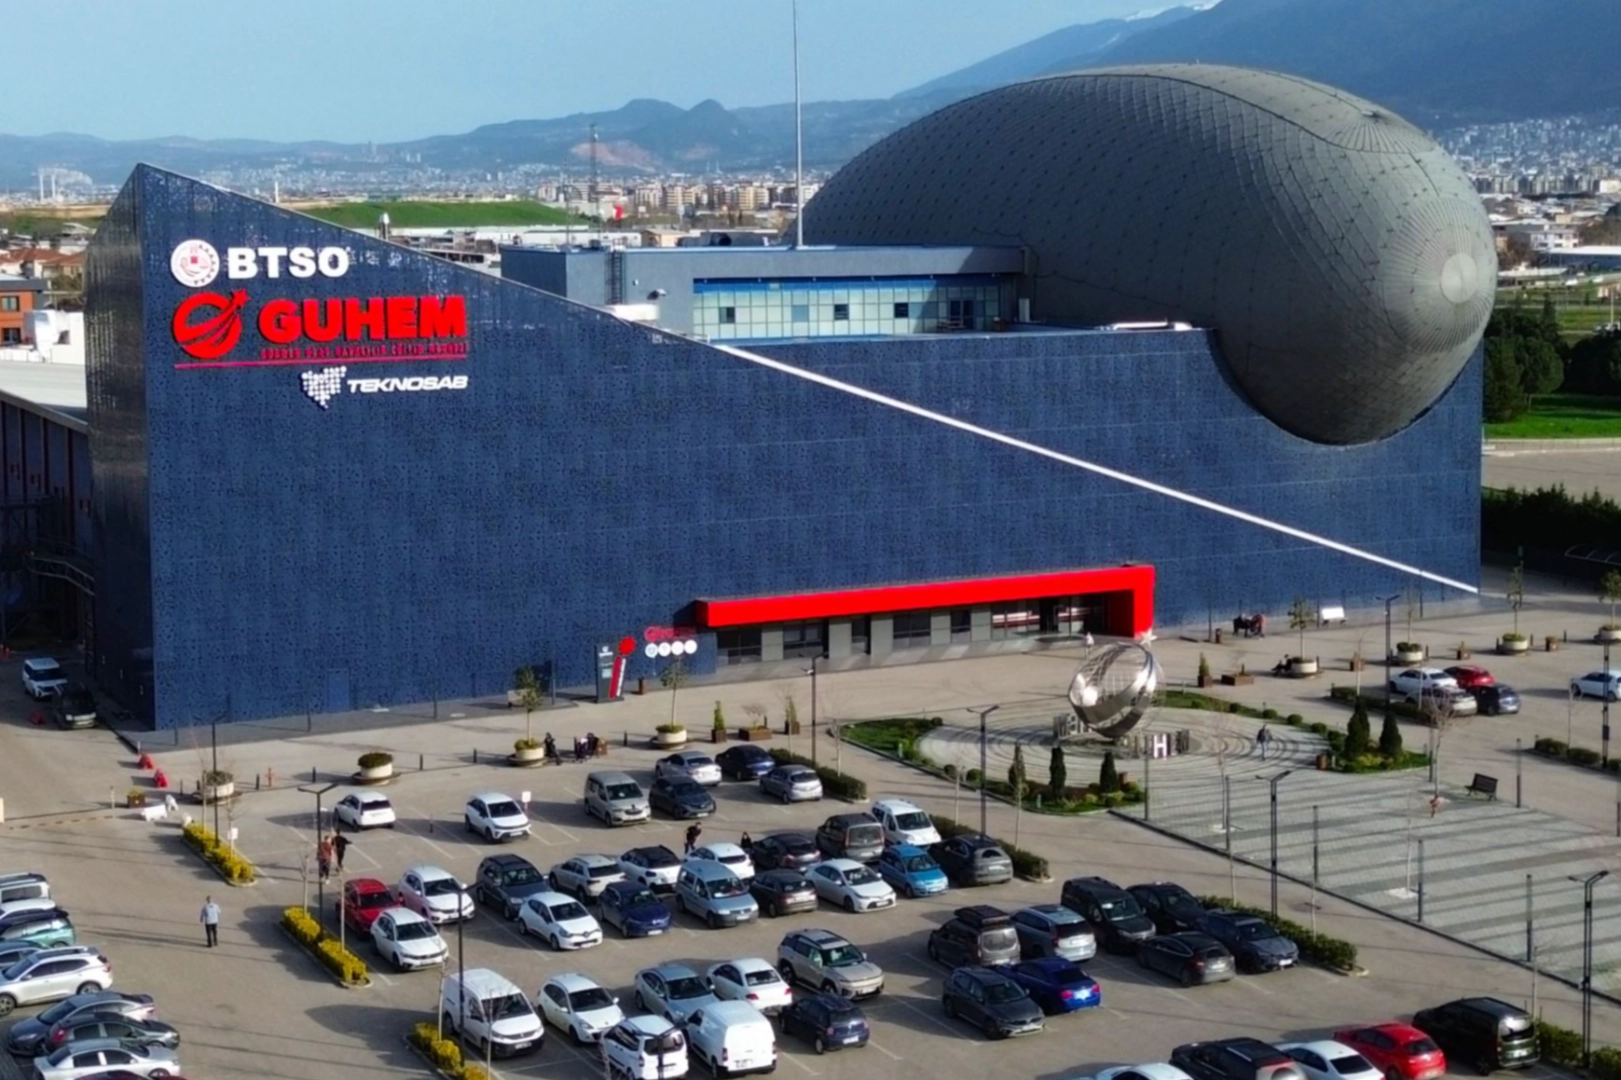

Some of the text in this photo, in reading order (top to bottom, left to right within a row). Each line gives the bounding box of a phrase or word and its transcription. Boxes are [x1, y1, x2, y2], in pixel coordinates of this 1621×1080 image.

[227, 247, 350, 279] BTSO
[259, 295, 468, 343] GUHEM
[347, 375, 469, 393] TEKNOSAB
